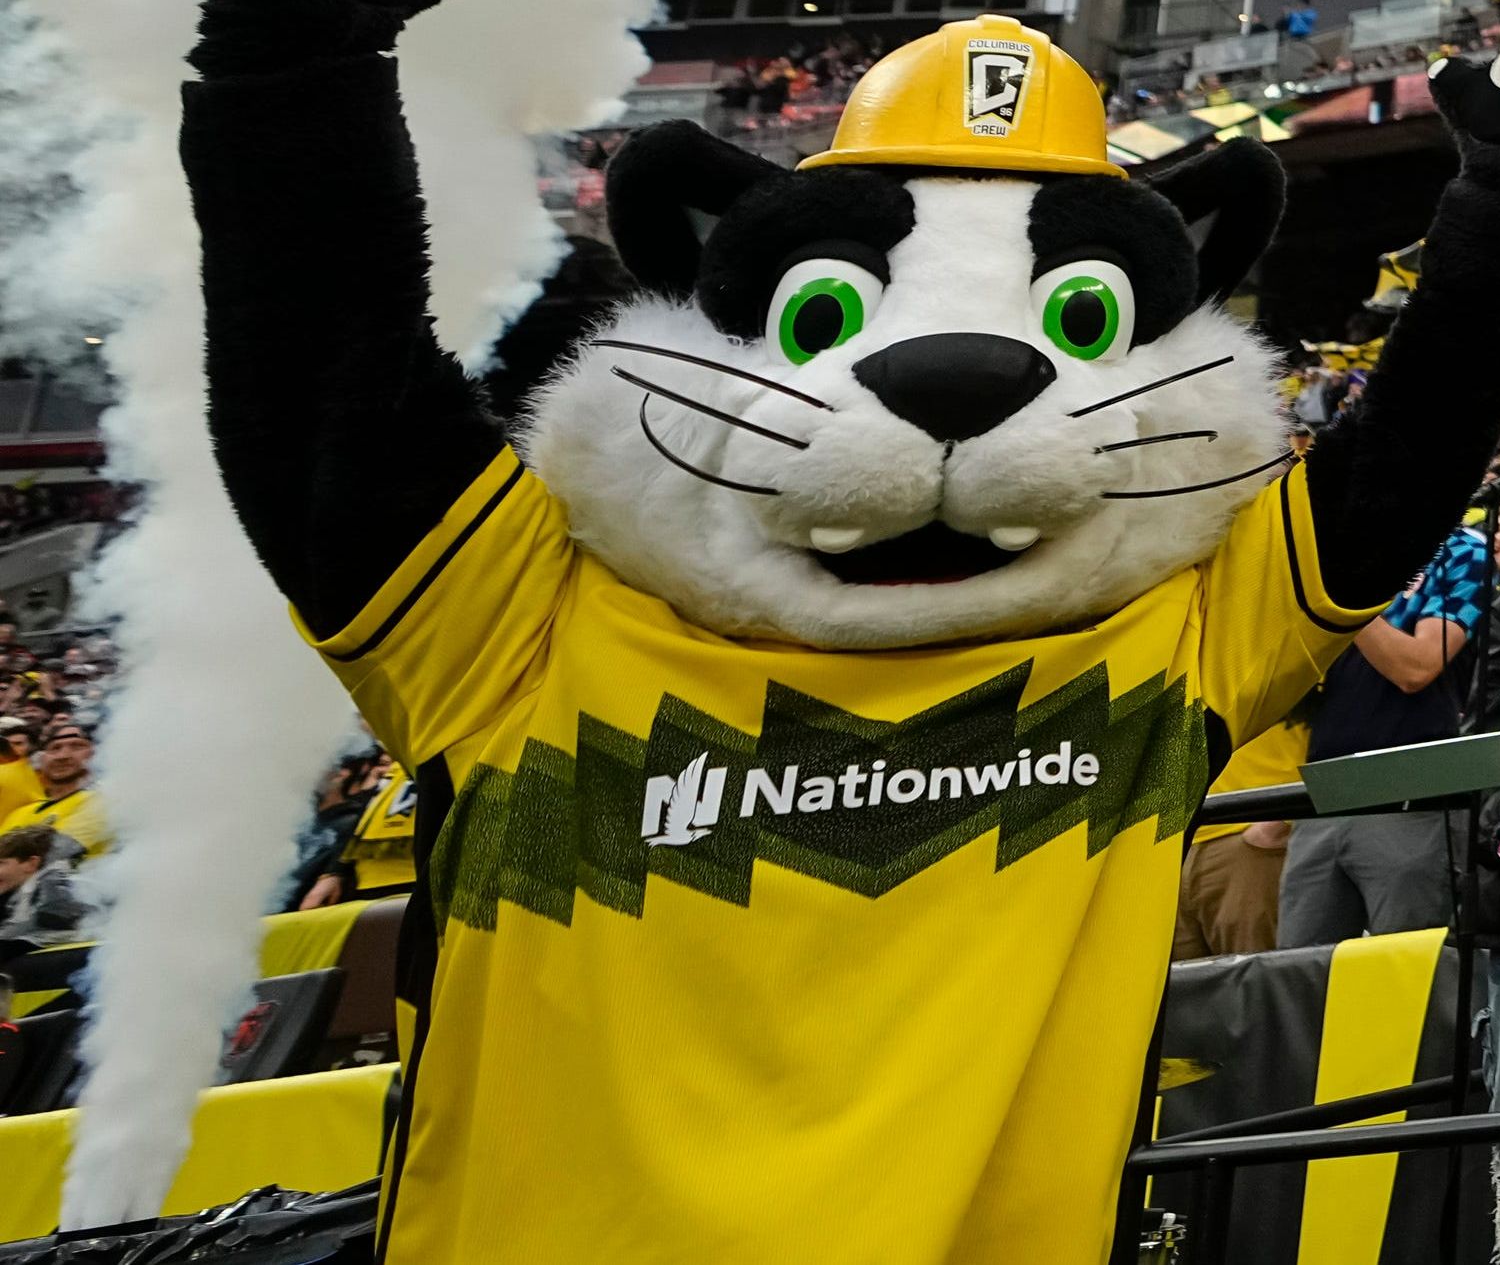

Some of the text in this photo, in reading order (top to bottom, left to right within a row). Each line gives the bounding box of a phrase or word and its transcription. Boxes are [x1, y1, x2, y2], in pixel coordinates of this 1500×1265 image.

[968, 40, 1031, 53] COLUMBUS
[1000, 107, 1013, 117] 96
[973, 125, 1006, 136] CREW
[739, 741, 1100, 818] Nationwide
